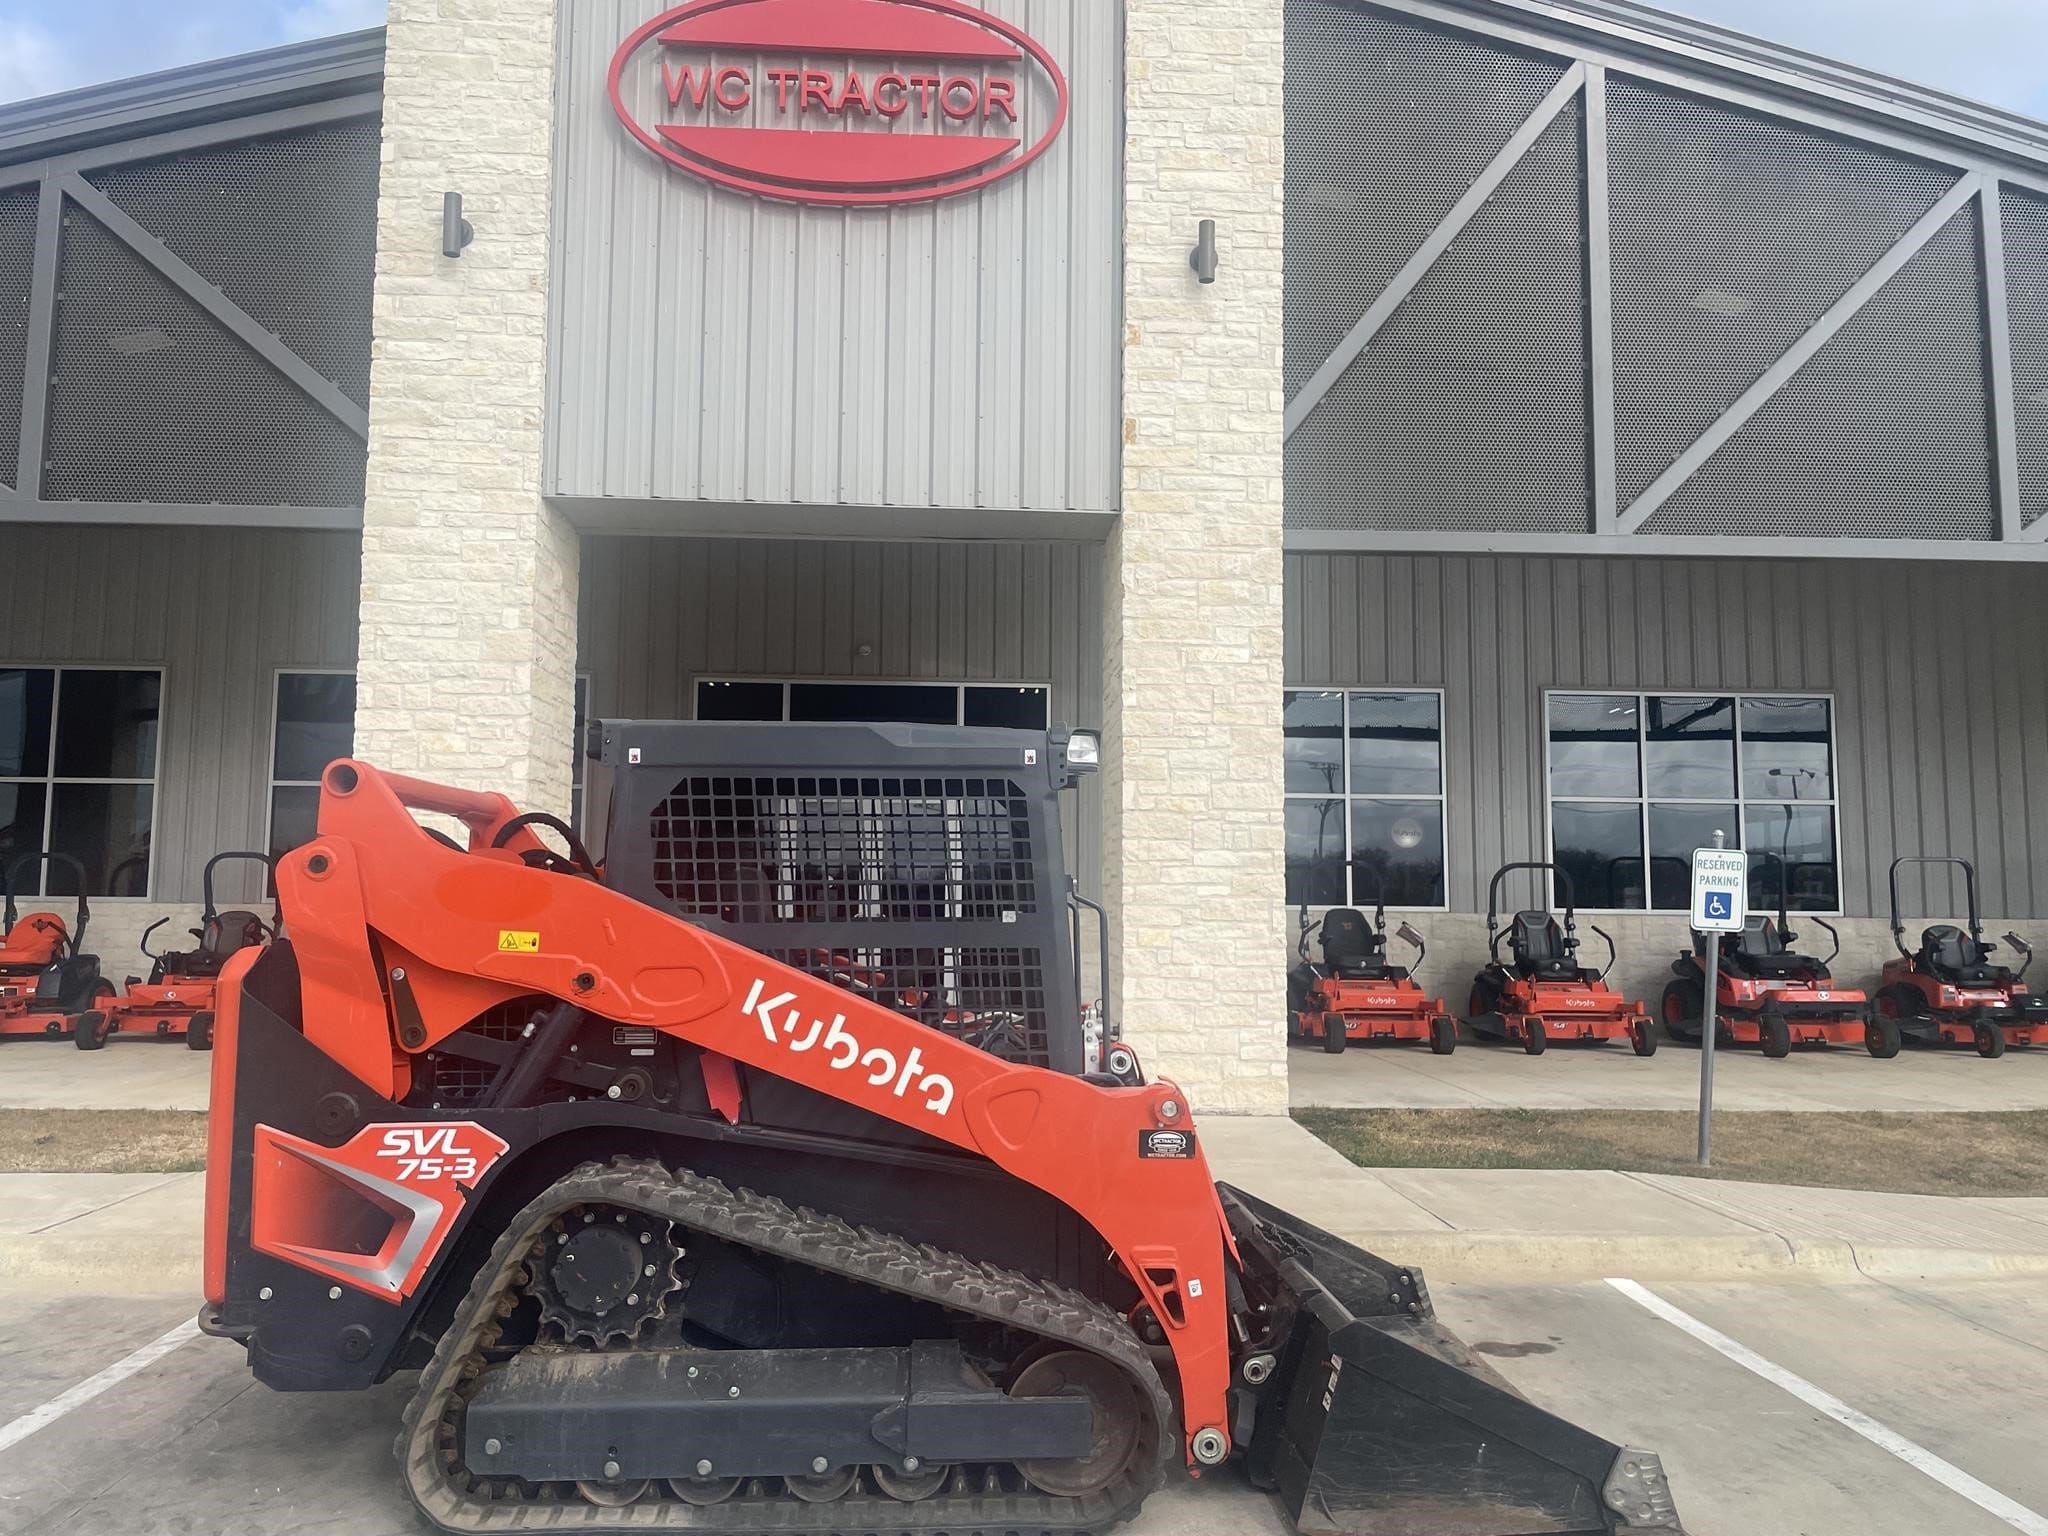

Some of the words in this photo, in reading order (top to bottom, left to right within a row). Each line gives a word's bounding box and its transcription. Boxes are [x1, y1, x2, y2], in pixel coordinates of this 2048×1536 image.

[661, 63, 751, 111] WC
[767, 69, 1018, 123] TRACTOR
[1697, 859, 1743, 871] RESERVED
[1699, 875, 1739, 887] PARKING
[1367, 996, 1396, 1005] Kubota
[1565, 999, 1595, 1007] Kubota
[741, 978, 955, 1116] Kubota
[376, 1128, 471, 1157] SVL
[396, 1157, 478, 1181] 75-3
